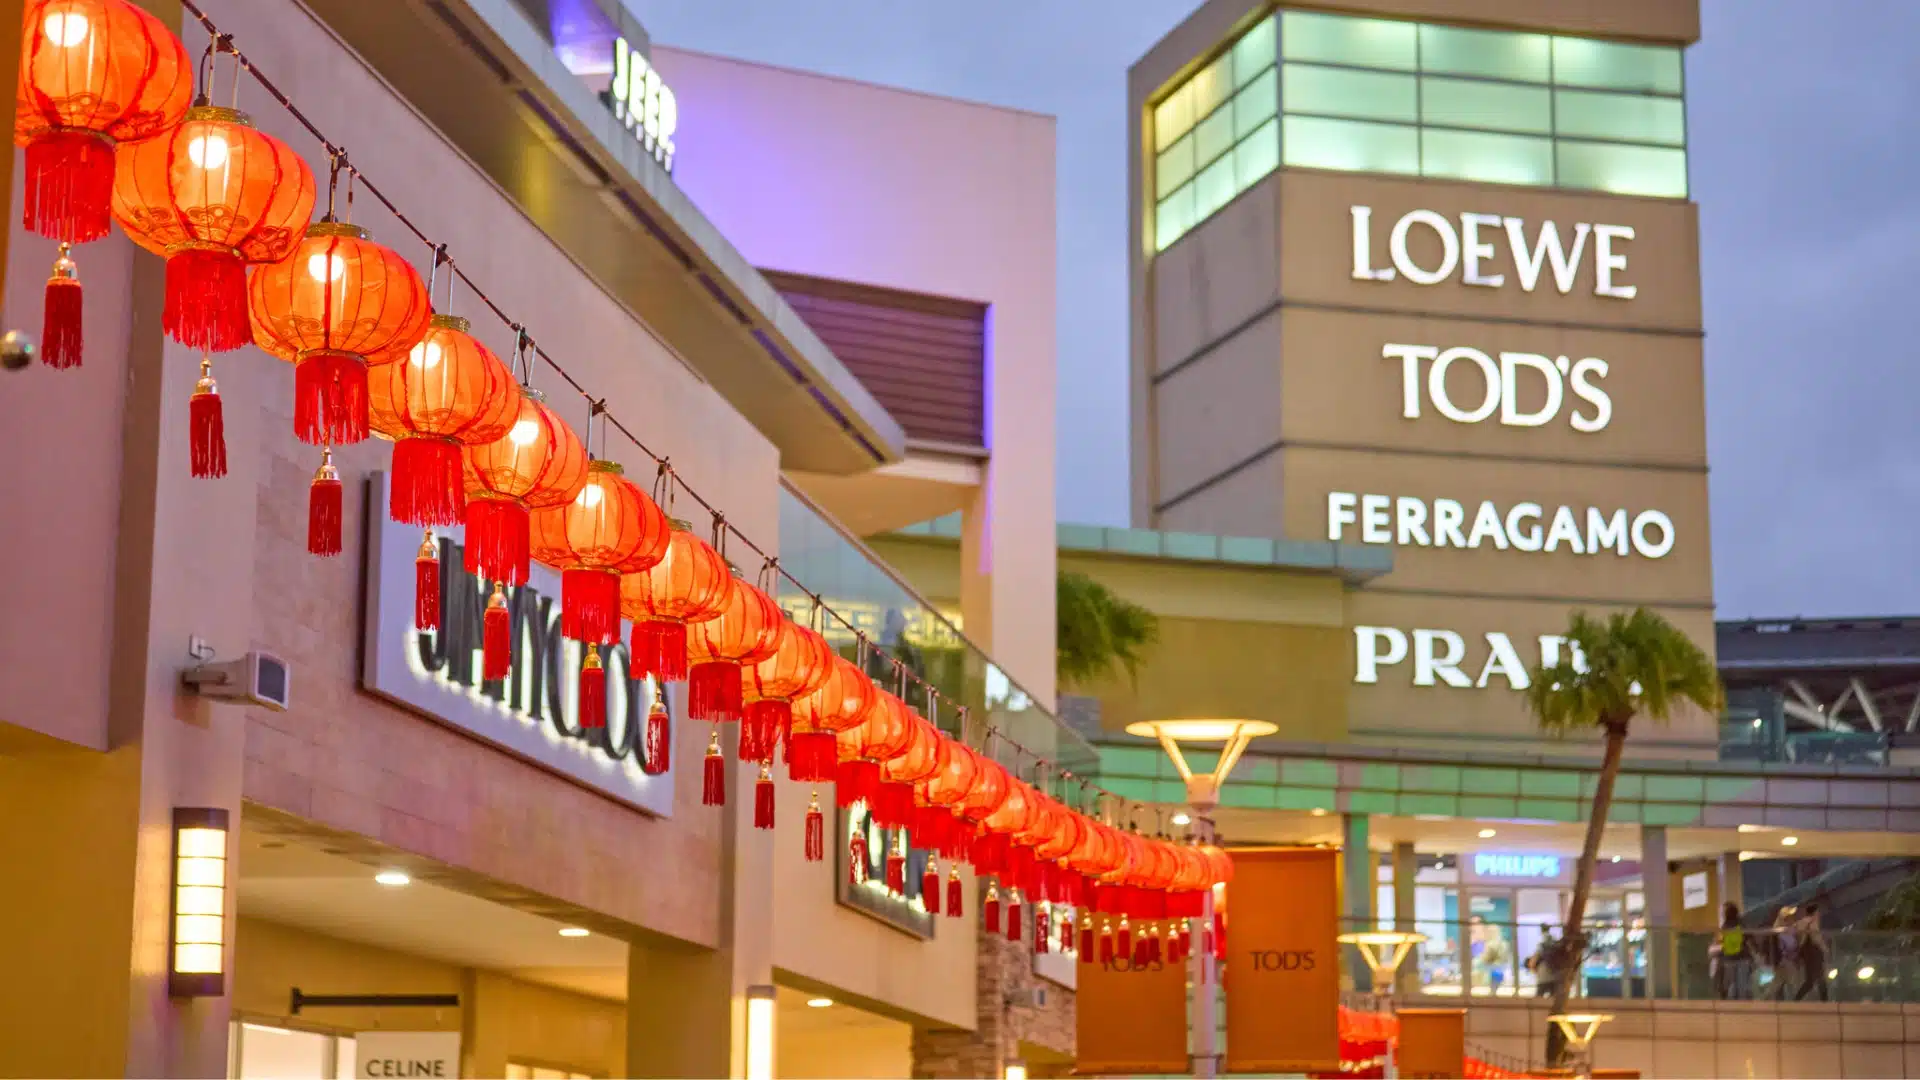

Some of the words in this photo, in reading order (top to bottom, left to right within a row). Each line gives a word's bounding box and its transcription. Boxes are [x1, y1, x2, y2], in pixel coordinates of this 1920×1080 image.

[1350, 205, 1637, 299] LOEWE
[1382, 343, 1613, 433] TOD'S
[1328, 491, 1675, 558] FERRAGAMO
[1353, 625, 1645, 695] PRAD
[1475, 854, 1559, 878] PHILIPS
[366, 1059, 444, 1077] CELINE
